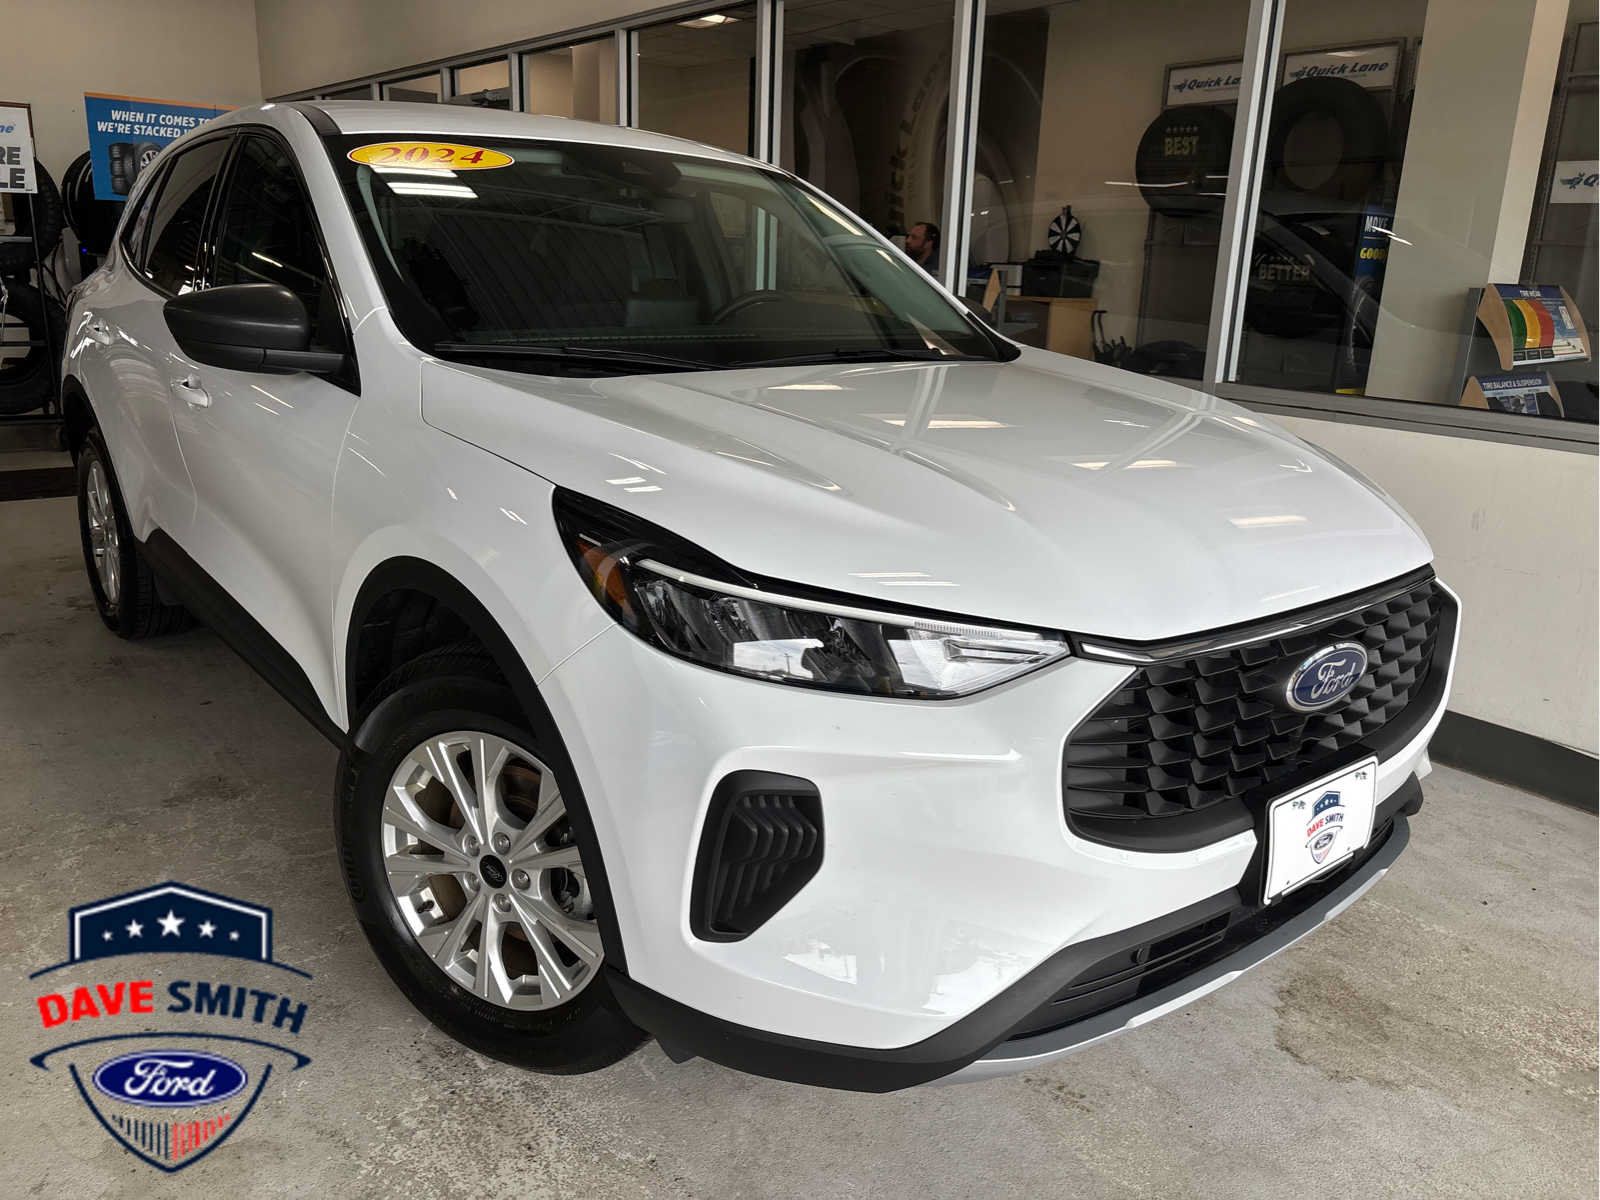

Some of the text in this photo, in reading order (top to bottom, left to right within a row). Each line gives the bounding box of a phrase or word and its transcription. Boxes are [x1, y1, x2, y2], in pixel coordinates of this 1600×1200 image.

[1306, 61, 1389, 78] Quick Lane
[1187, 76, 1222, 90] Quick
[111, 110, 144, 122] WHEN
[146, 113, 157, 123] IT
[159, 115, 195, 127] COMES
[97, 121, 131, 134] WE'RE
[133, 125, 181, 138] STACKED
[377, 146, 485, 164] 2024
[1164, 136, 1199, 156] BEST
[1259, 263, 1310, 281] BETTER
[1310, 658, 1356, 700] Ford
[1307, 812, 1344, 837] DAVE SMITH
